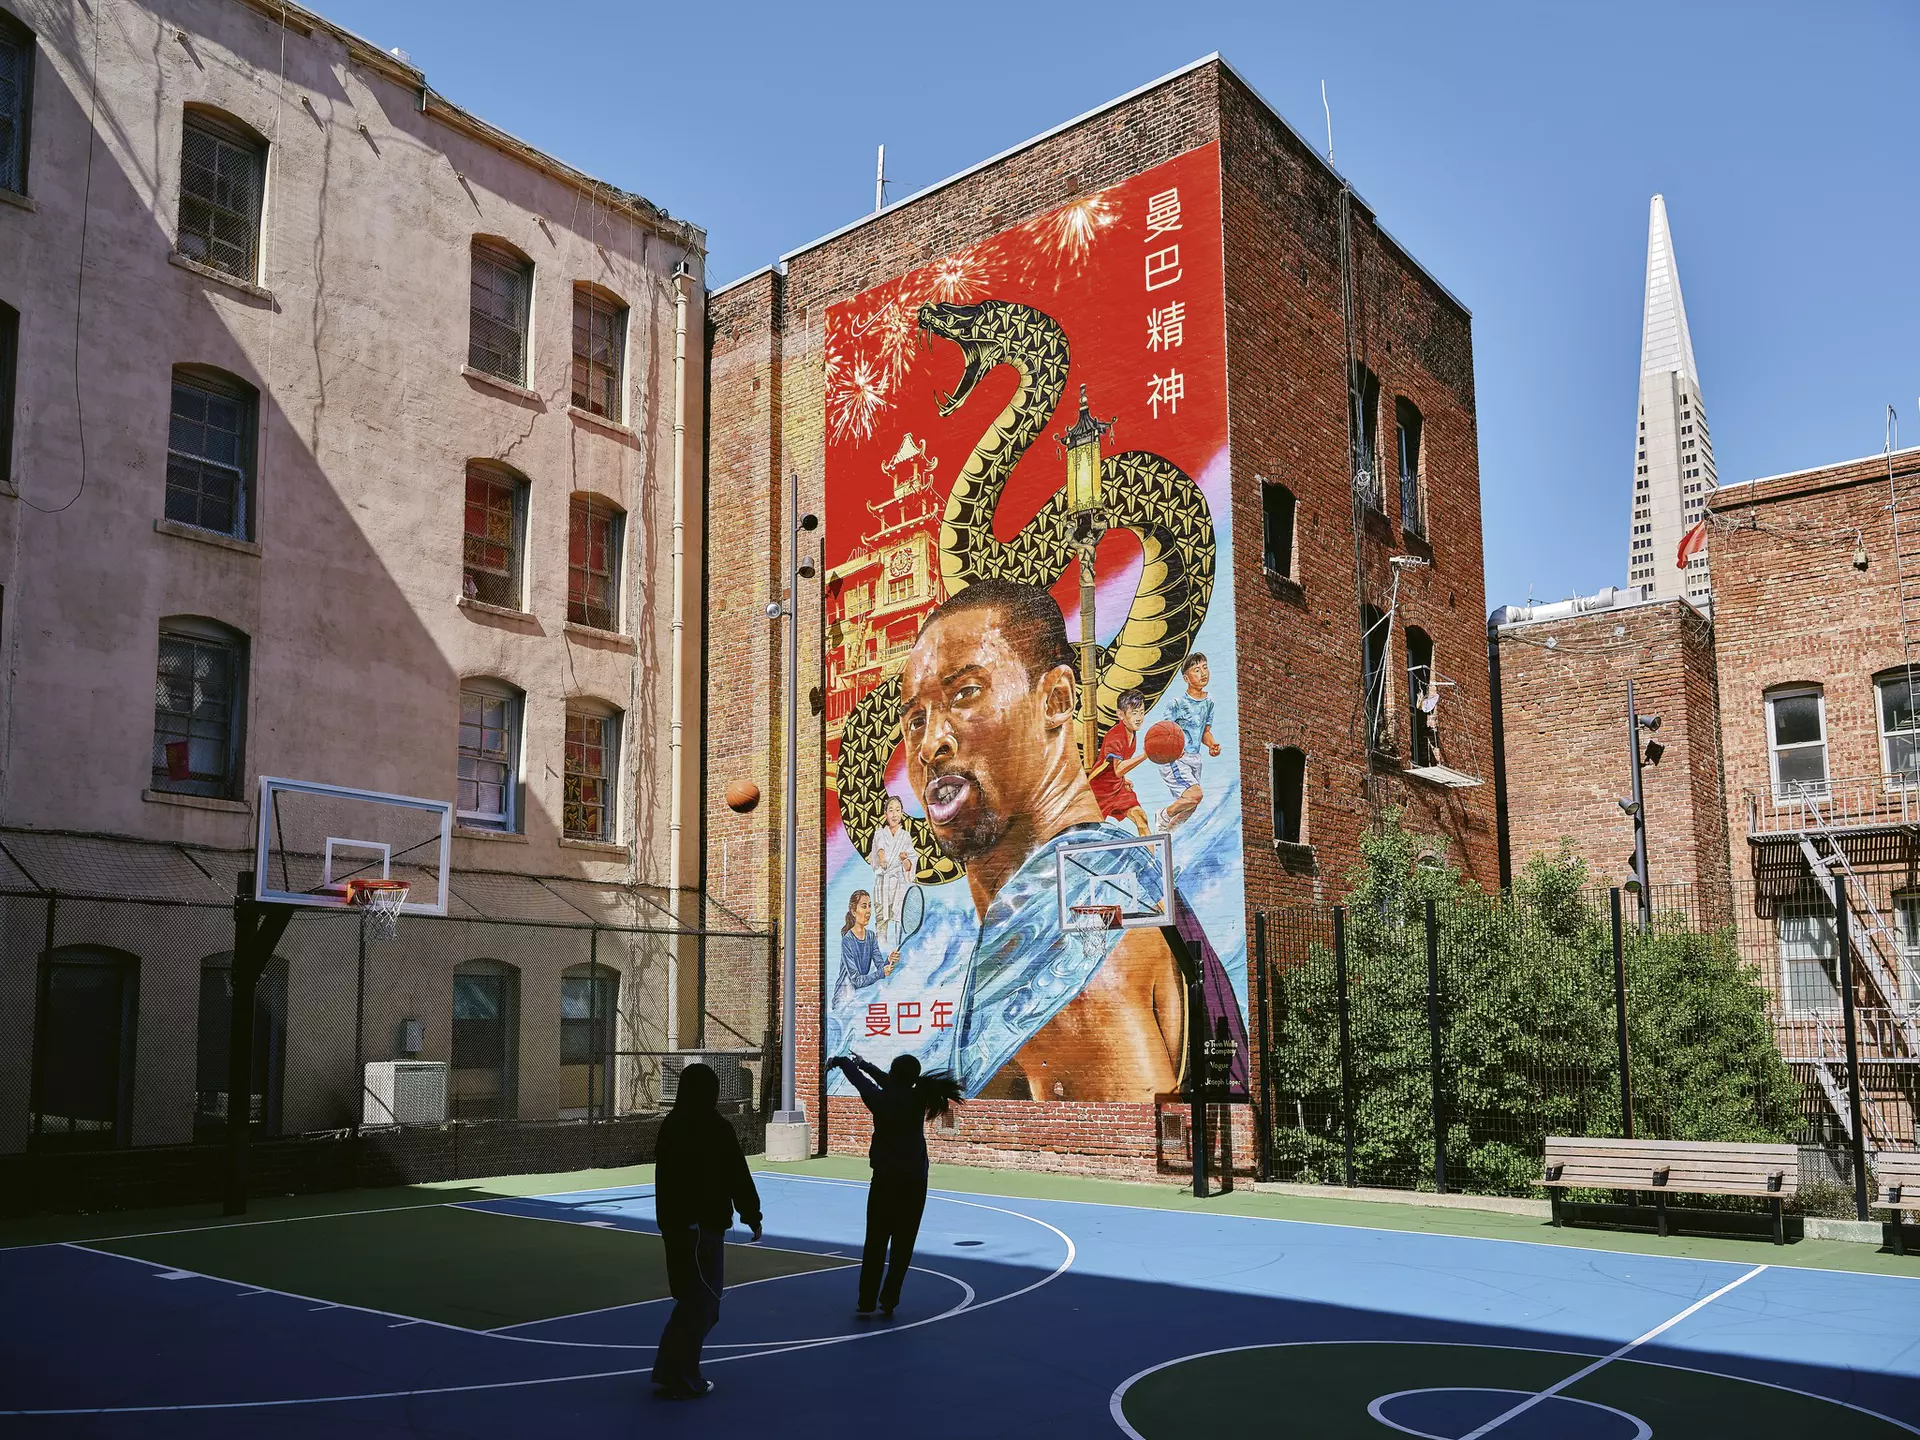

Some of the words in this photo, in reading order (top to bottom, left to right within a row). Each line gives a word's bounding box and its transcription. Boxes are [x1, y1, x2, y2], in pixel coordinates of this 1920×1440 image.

[1144, 187, 1186, 420] 曼巴精神
[865, 1000, 953, 1037] 曼巴年
[1211, 1048, 1236, 1057] Company
[1210, 1061, 1229, 1071] Vogue
[1205, 1078, 1224, 1087] Joseph
[1226, 1079, 1240, 1087] Lopez
